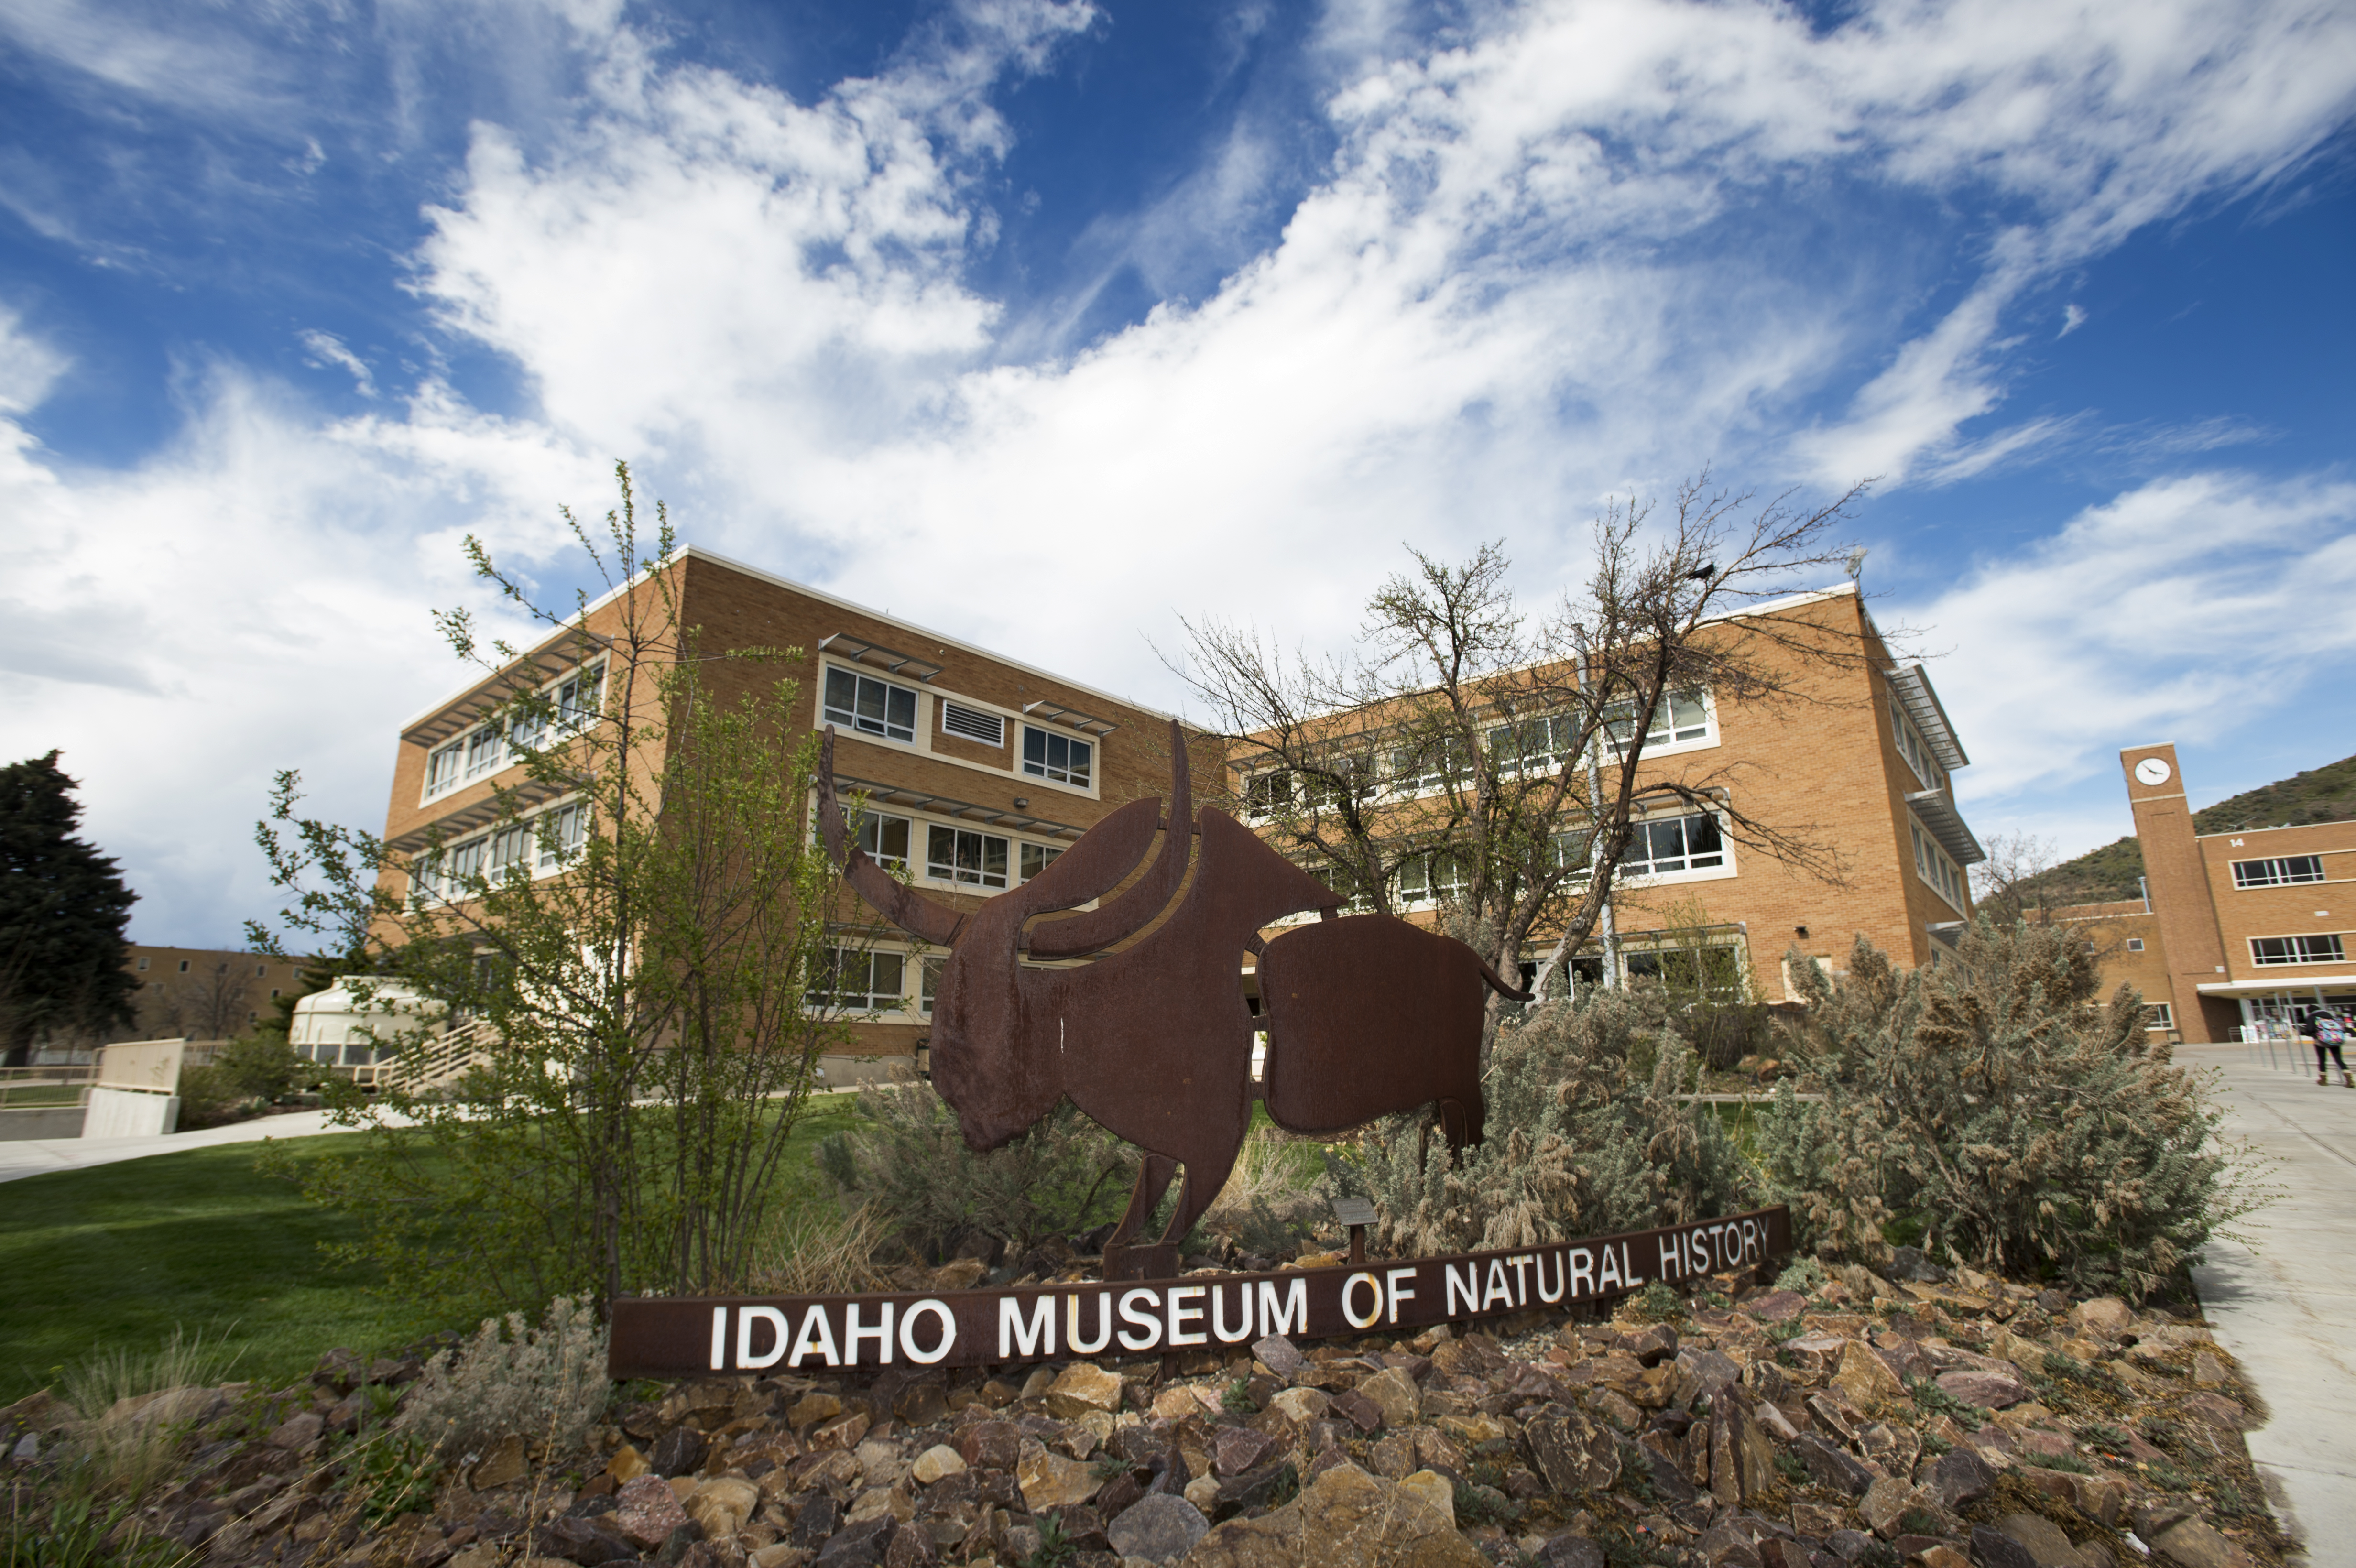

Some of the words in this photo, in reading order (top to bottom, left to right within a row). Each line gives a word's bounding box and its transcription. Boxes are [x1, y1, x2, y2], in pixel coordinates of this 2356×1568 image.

[2229, 838, 2245, 847] 14
[710, 1299, 957, 1370] IDAHO
[999, 1278, 1308, 1358] MUSEUM
[1342, 1268, 1416, 1328] OF
[1446, 1241, 1643, 1316] NATURAL
[1659, 1215, 1768, 1282] HISTORY
